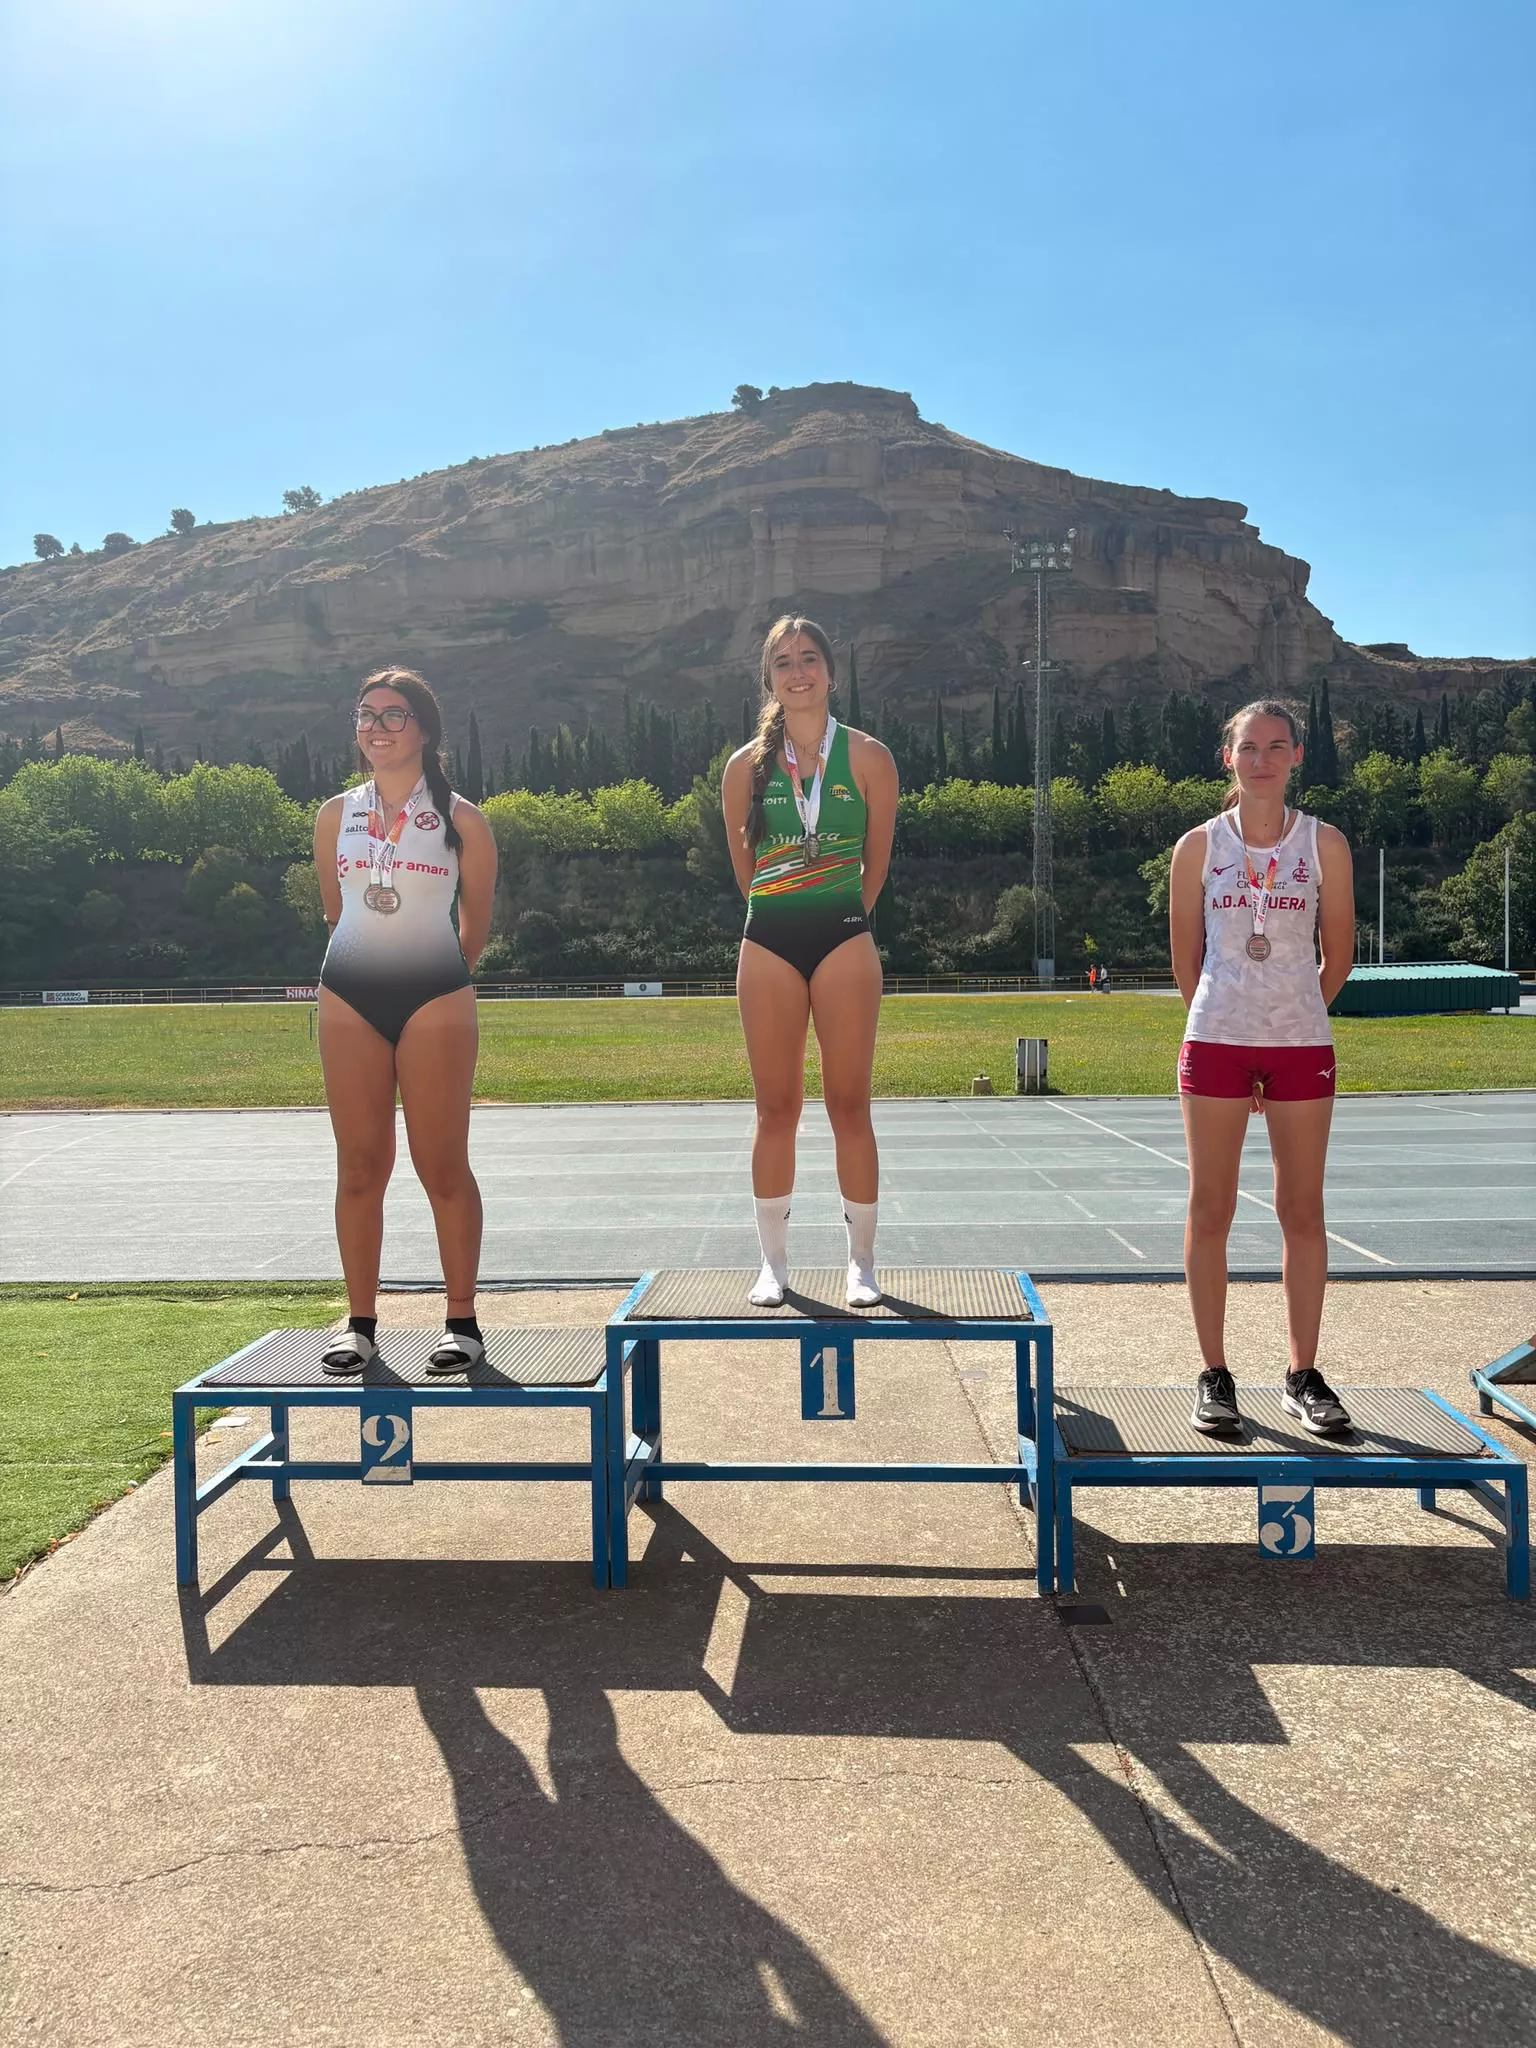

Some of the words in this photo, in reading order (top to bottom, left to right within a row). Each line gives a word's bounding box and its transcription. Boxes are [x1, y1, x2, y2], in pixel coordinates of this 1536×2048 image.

[769, 832, 840, 846] Hueca
[355, 859, 404, 870] suer
[406, 861, 449, 876] amara
[1268, 897, 1306, 911] UERA
[809, 1347, 846, 1416] 1
[361, 1414, 412, 1481] 2
[1260, 1485, 1312, 1555] 3
